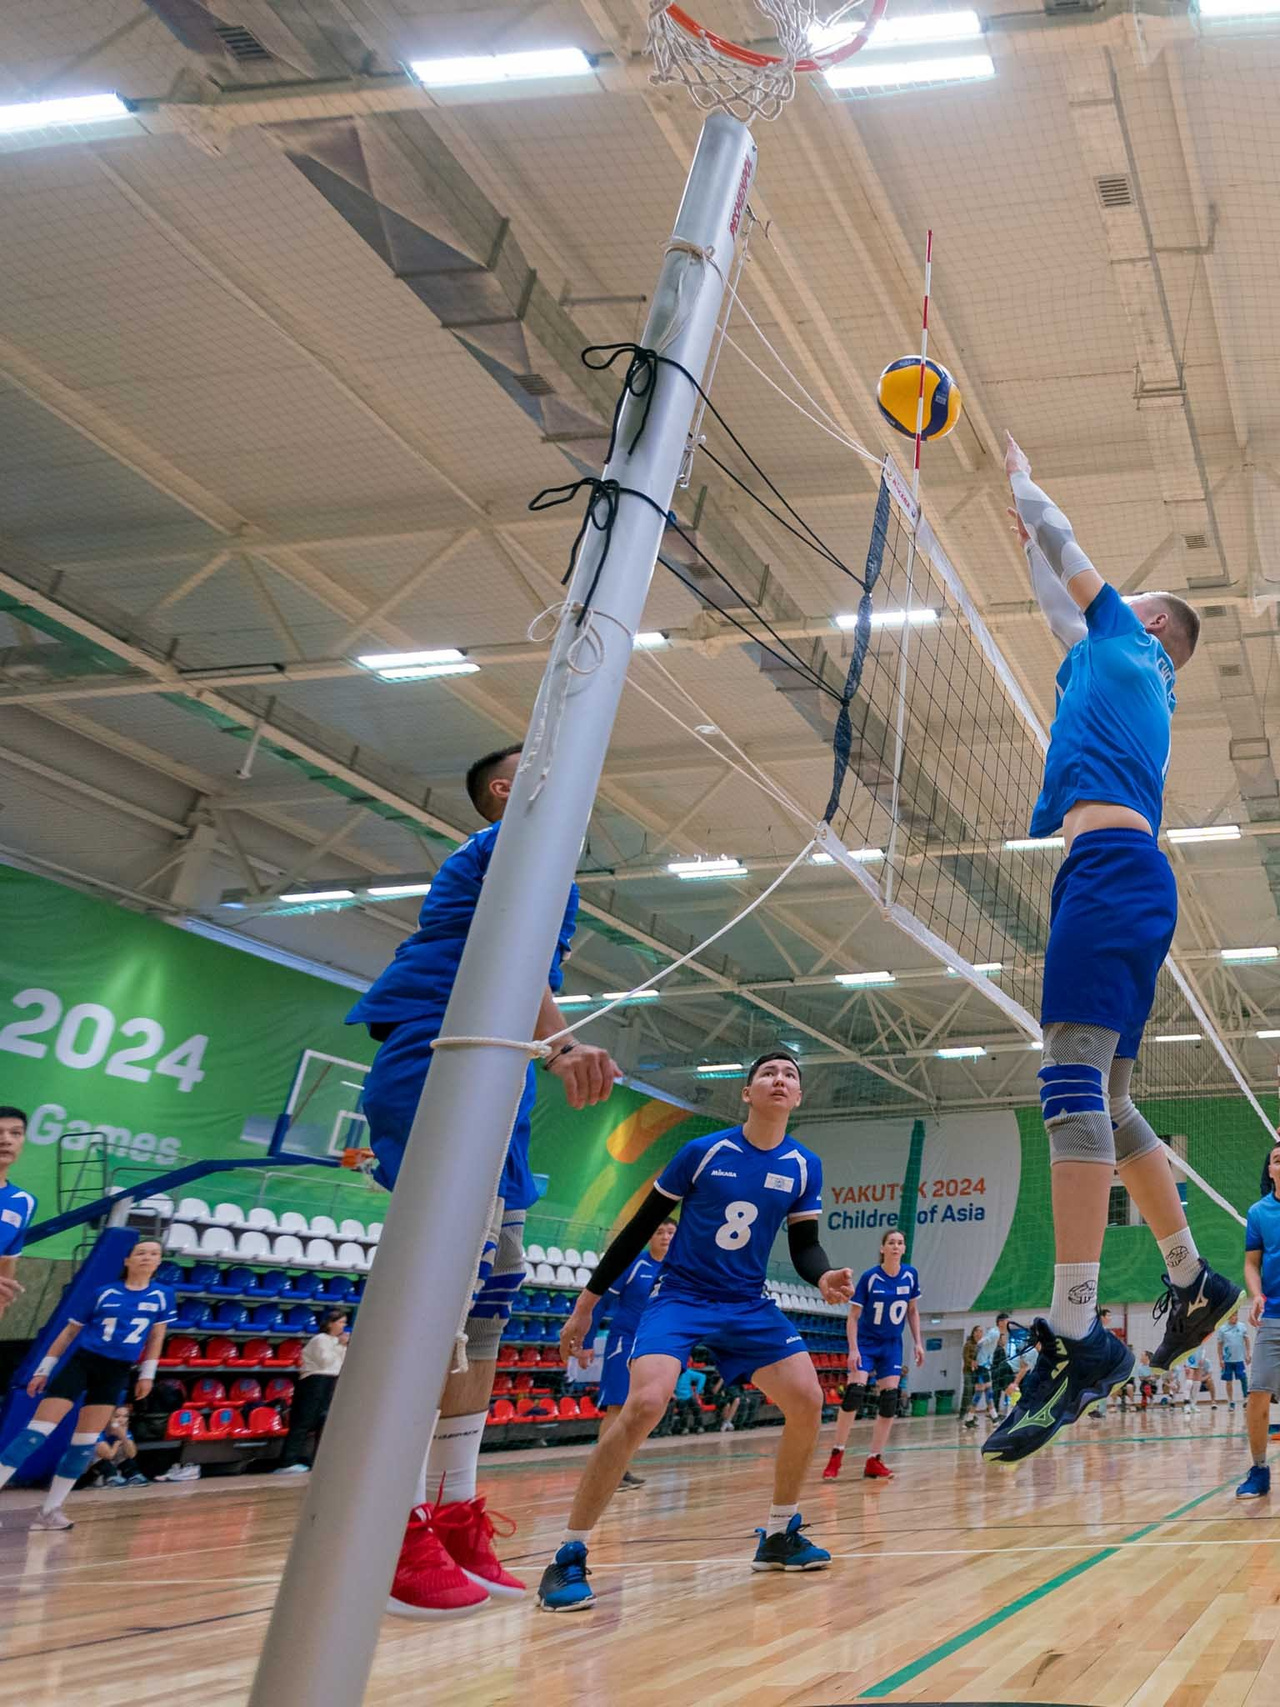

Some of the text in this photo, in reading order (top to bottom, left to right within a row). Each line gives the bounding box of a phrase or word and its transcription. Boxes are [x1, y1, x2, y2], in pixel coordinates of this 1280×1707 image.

[0, 988, 209, 1093] 2024
[26, 1104, 182, 1165] Games
[831, 1177, 986, 1205] YAKUTK 2024
[715, 1200, 759, 1251] 8
[827, 1202, 986, 1230] Childre of Asia
[873, 1300, 908, 1325] 10
[101, 1317, 150, 1344] 12
